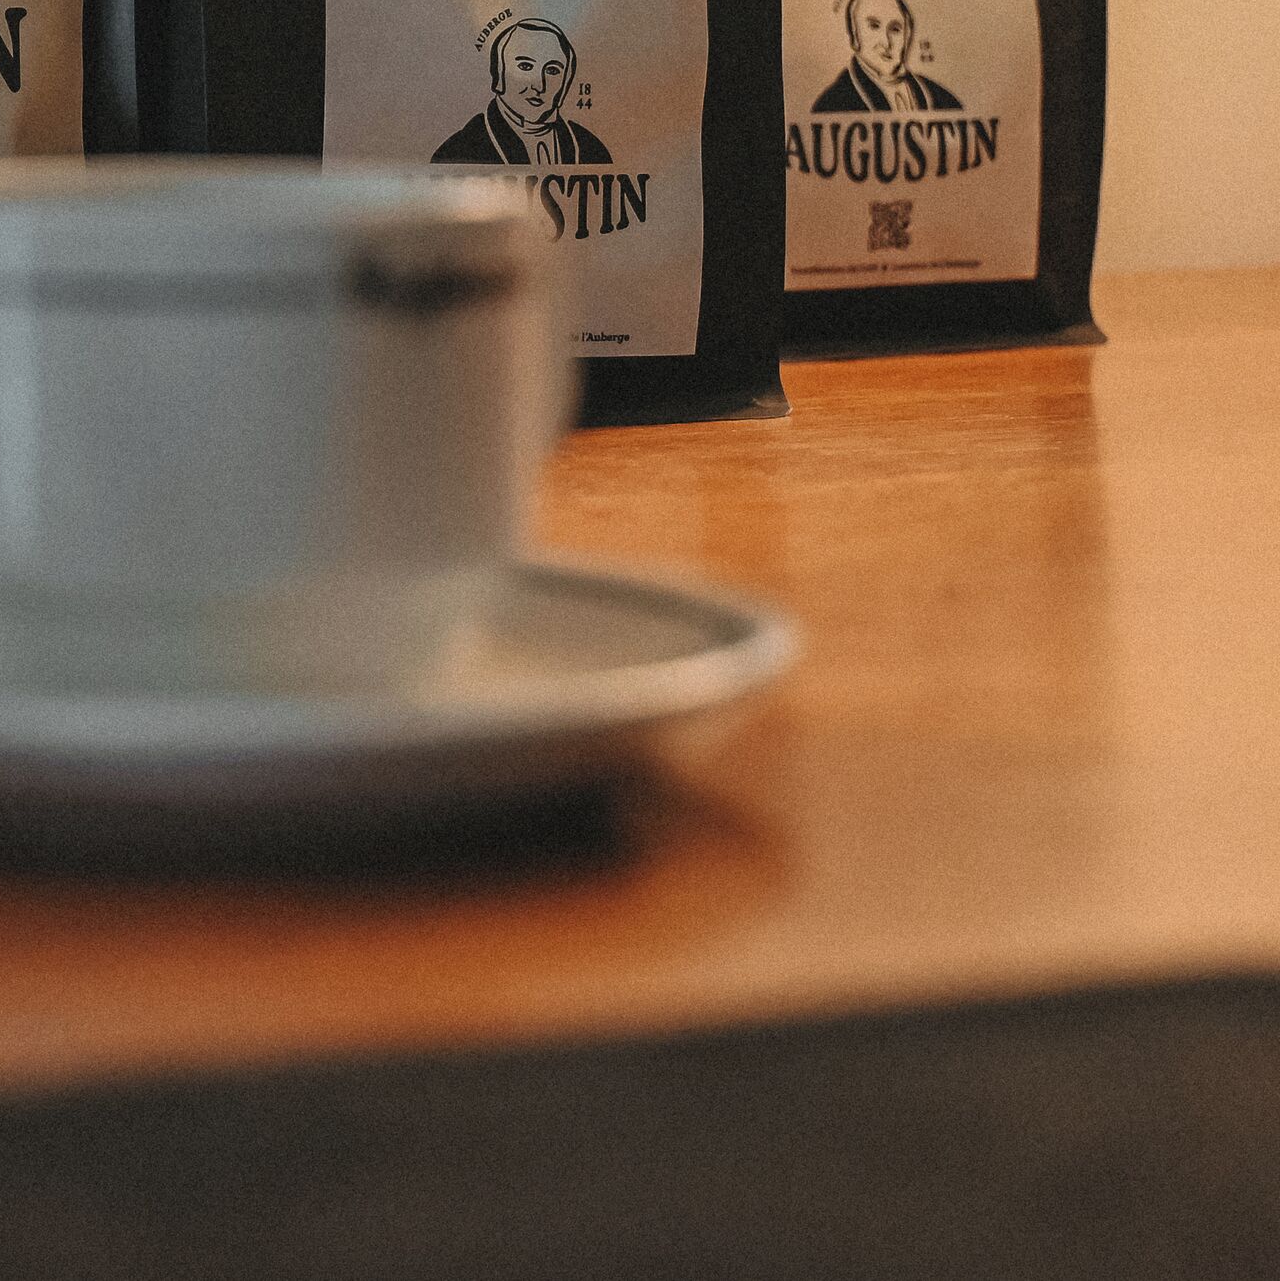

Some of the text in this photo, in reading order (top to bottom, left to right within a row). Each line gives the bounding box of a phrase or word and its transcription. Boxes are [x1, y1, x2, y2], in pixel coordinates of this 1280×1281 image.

[474, 8, 513, 52] AUBERGE
[579, 83, 592, 96] 18
[576, 98, 593, 110] 44
[785, 118, 999, 184] AUGUSTIN
